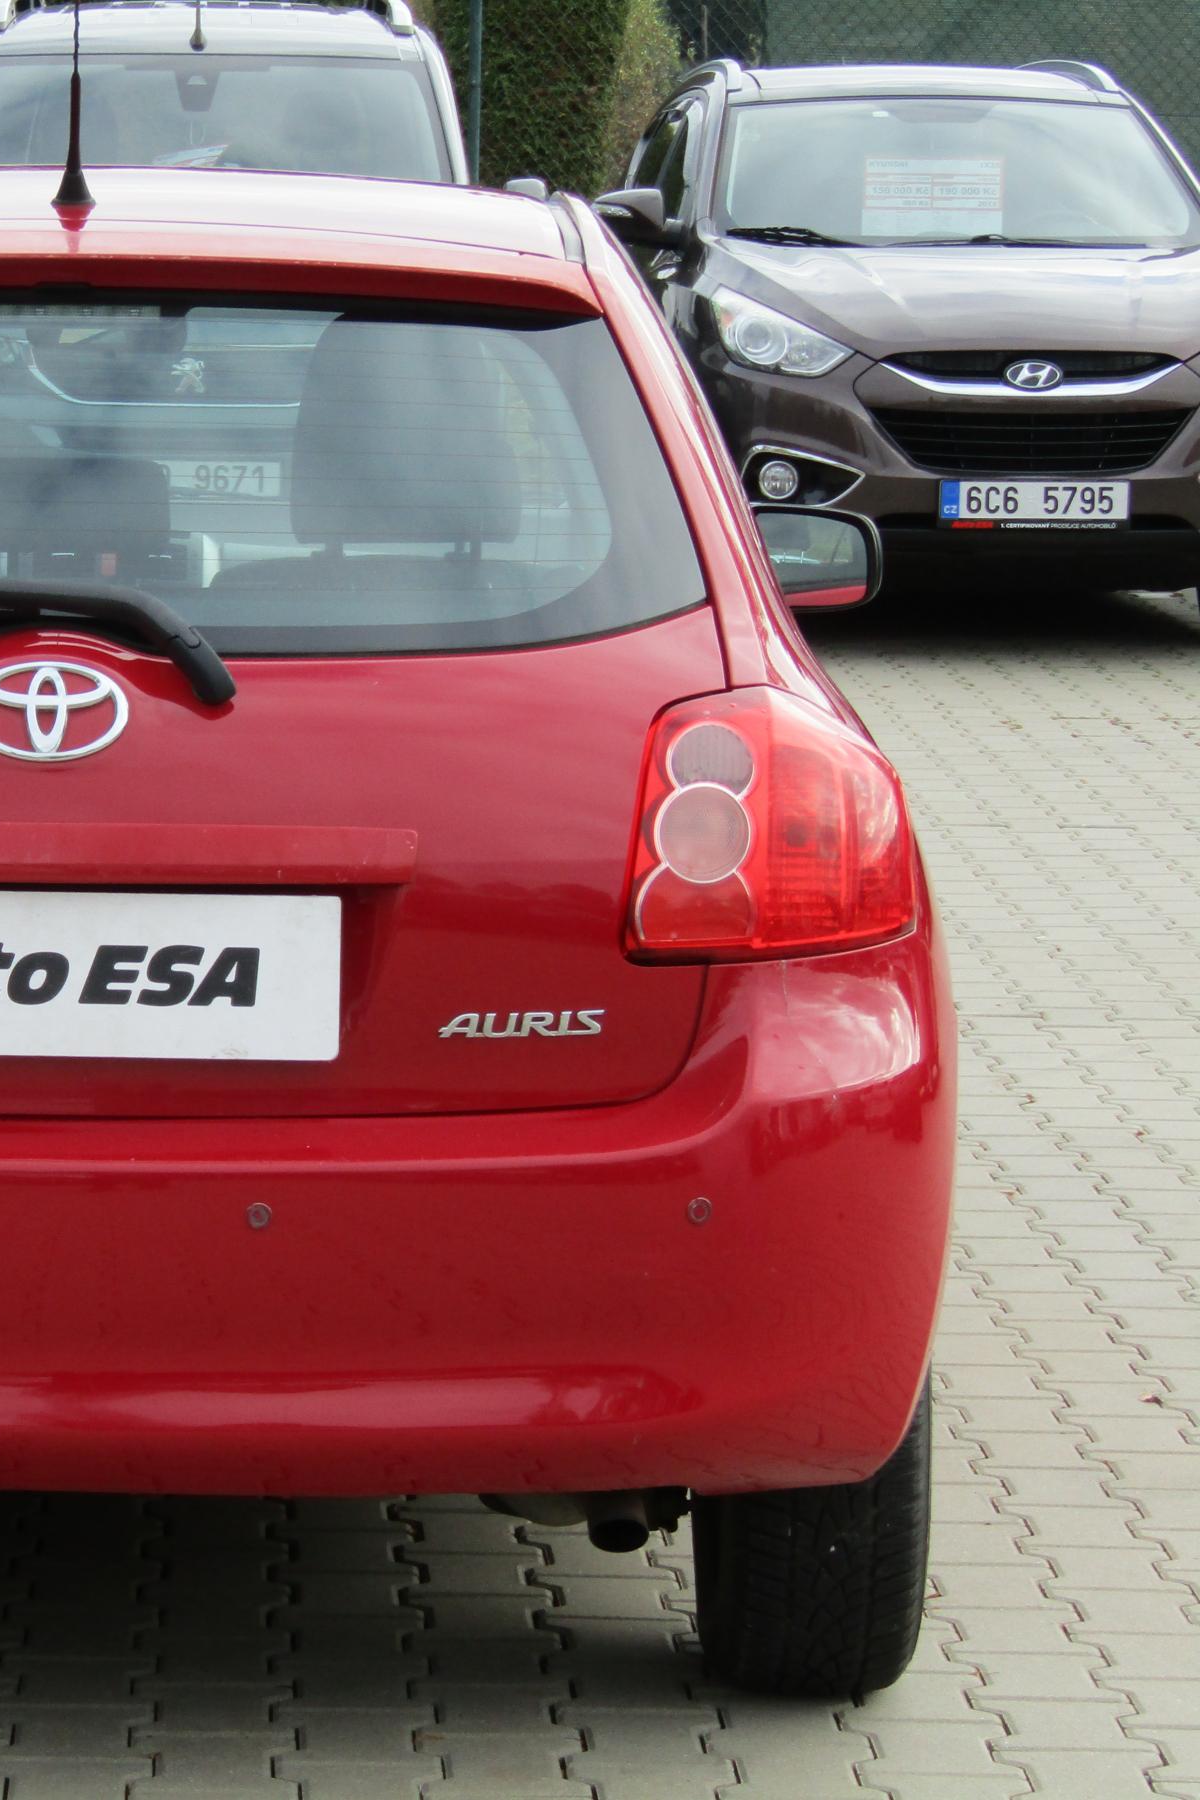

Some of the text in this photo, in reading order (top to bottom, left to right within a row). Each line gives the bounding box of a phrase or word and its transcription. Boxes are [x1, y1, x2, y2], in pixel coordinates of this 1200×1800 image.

[194, 464, 265, 494] 9671
[944, 505, 957, 514] CZ
[966, 486, 1113, 514] 6C6 5795
[78, 945, 260, 1007] ESA
[438, 1009, 605, 1038] AURIS
